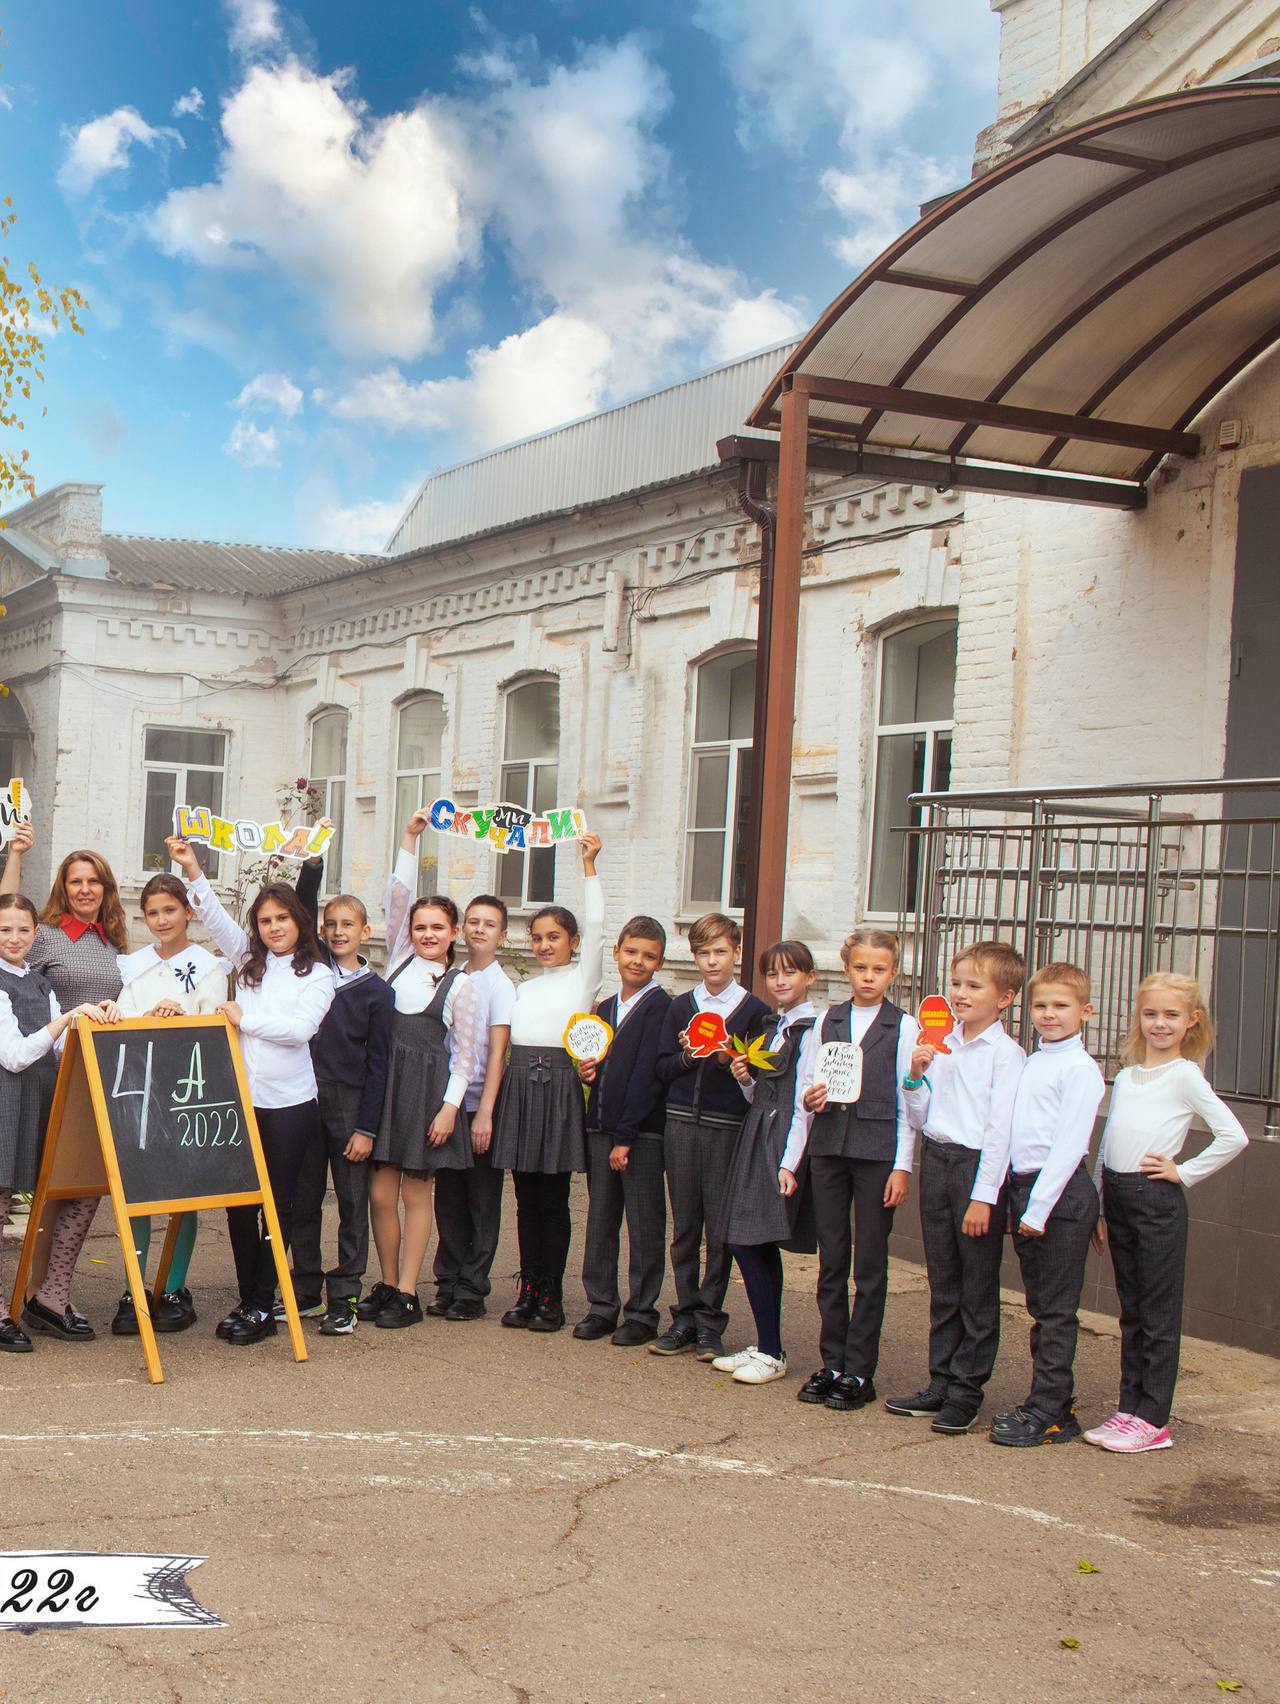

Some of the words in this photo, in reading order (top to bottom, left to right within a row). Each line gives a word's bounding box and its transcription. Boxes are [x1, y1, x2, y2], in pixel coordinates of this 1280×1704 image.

[175, 806, 331, 858] ШКОЛА!
[431, 799, 583, 849] СКУЧАЛИ!
[111, 1041, 153, 1150] 4
[172, 1041, 206, 1103] А
[177, 1108, 243, 1147] 2022
